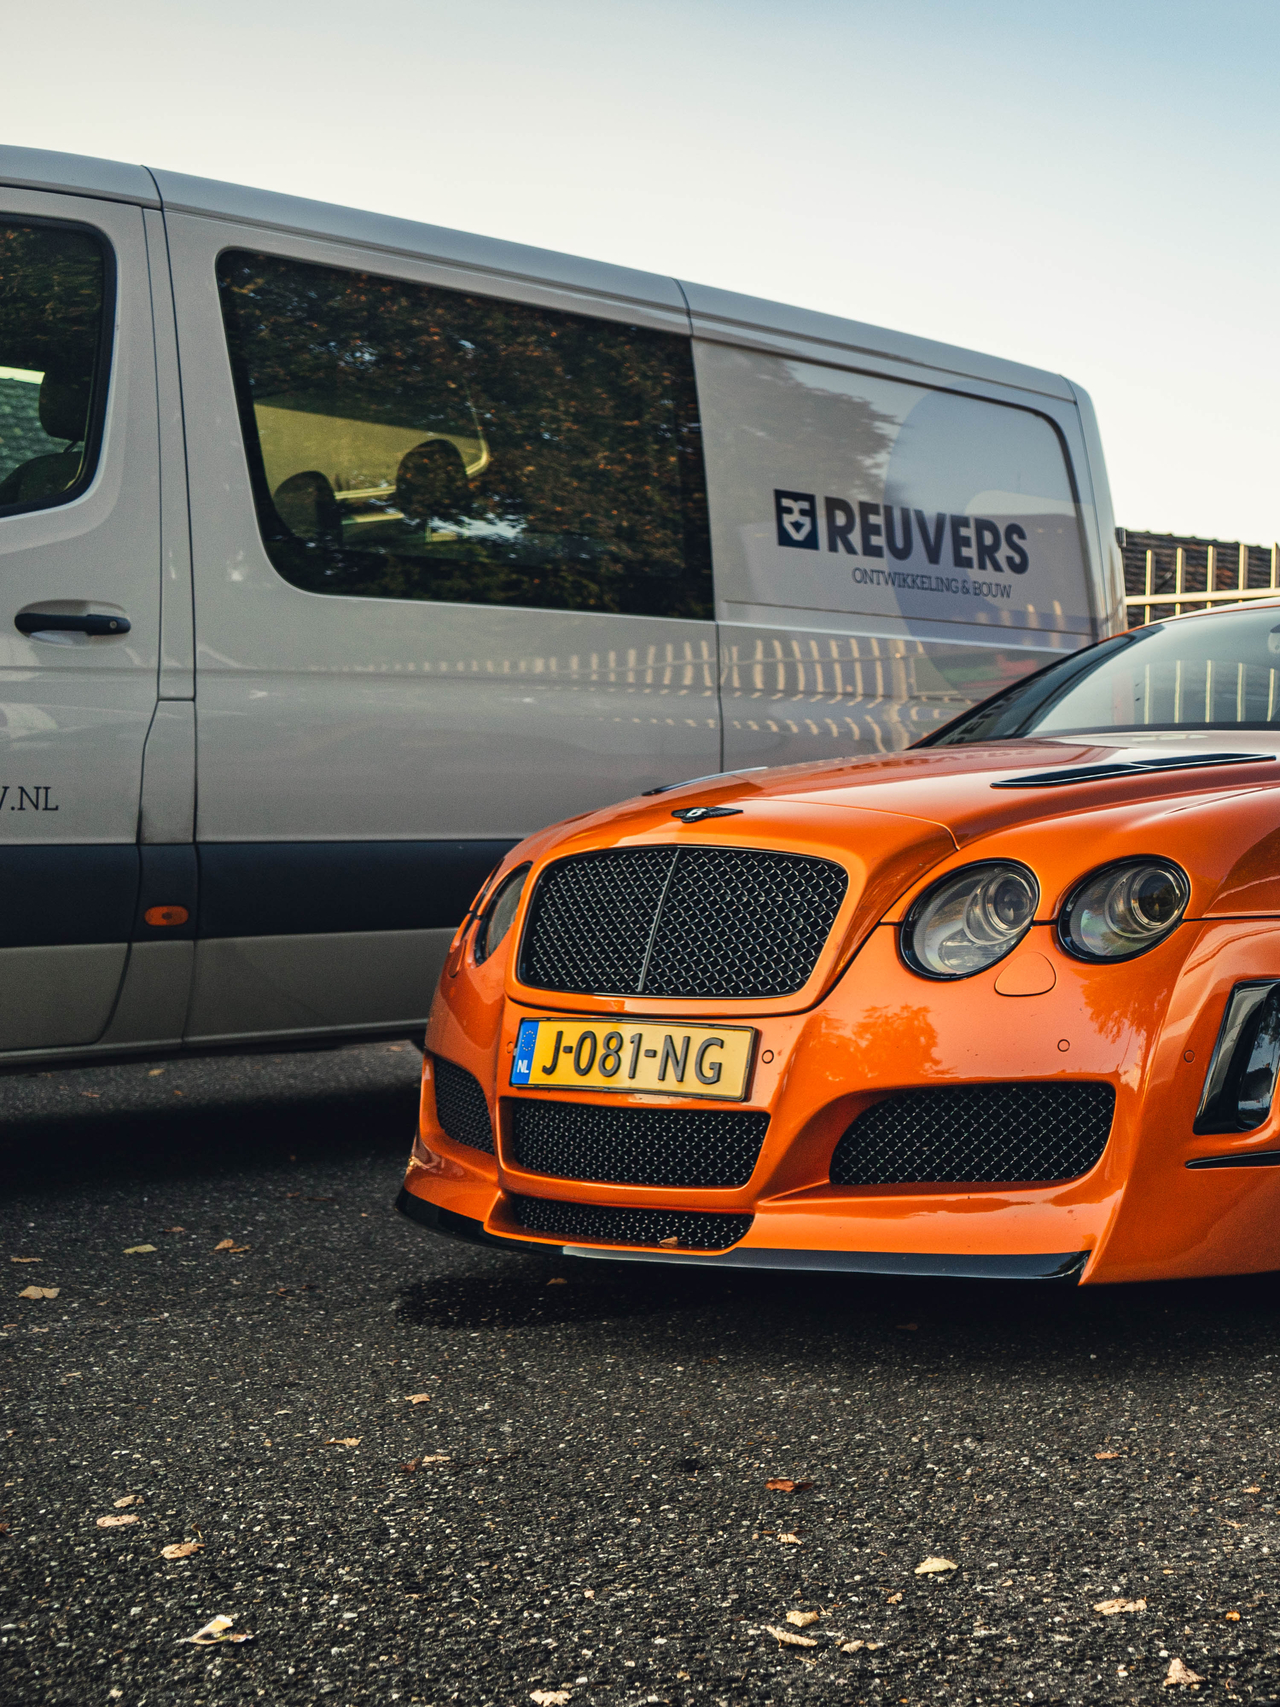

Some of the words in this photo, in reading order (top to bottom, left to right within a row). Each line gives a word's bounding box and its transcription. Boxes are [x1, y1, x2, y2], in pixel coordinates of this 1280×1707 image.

[824, 496, 1029, 575] REUVERS
[852, 567, 959, 594] ONTWIKKELING
[961, 580, 971, 595] &
[973, 580, 1012, 598] BOUW
[516, 1059, 529, 1074] NL
[541, 1030, 724, 1085] J-081-NG
